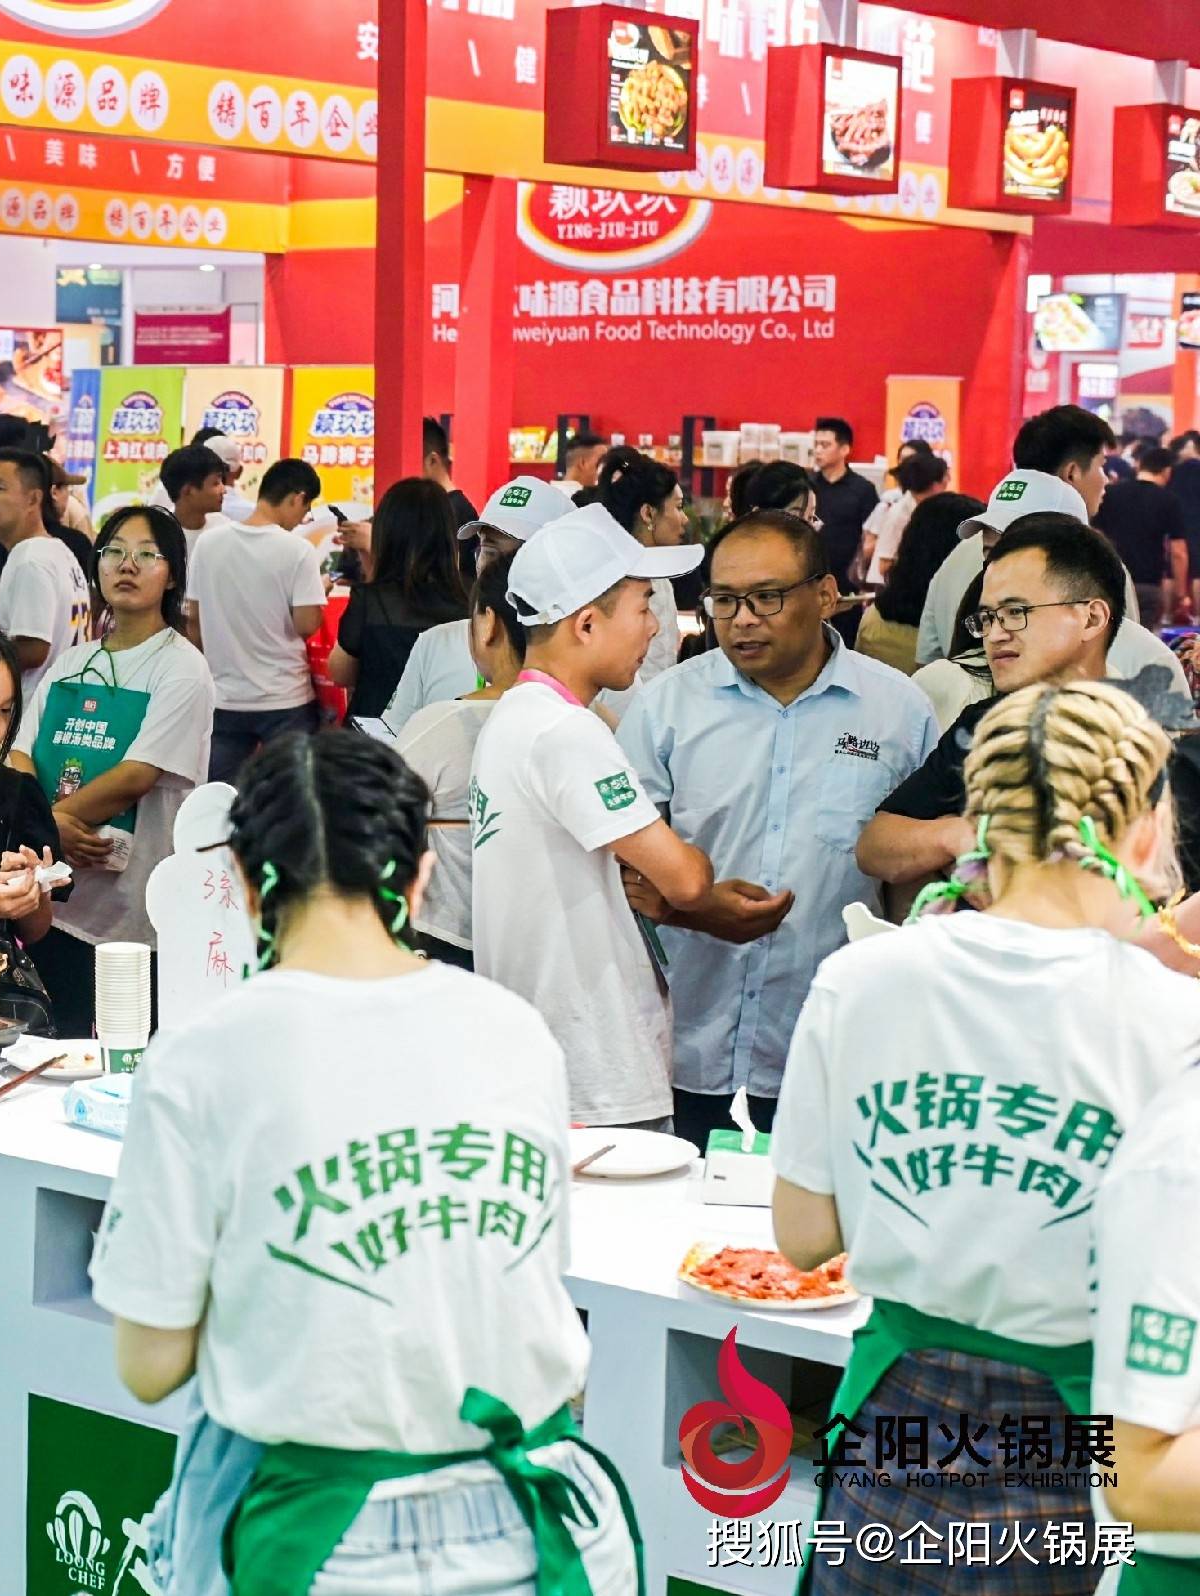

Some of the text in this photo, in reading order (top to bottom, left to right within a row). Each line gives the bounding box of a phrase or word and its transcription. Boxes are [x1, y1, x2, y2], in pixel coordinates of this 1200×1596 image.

[44, 139, 99, 170] 美味
[166, 153, 218, 183] 方便
[557, 220, 660, 240] YING-JIU-JIU
[432, 274, 837, 319] 河味源食品科技有限公司
[596, 319, 642, 342] Food
[647, 318, 755, 345] Technology
[761, 317, 797, 342] Co.,
[803, 317, 835, 340] Ltd
[64, 717, 109, 735] 开创中国
[856, 1071, 1126, 1169] 火锅专用
[273, 1123, 548, 1244] 火锅专用
[905, 1142, 1083, 1210] 好牛肉
[355, 1194, 528, 1276] 好牛肉
[55, 1547, 106, 1577] LOONG
[68, 1566, 106, 1590] CHEF
